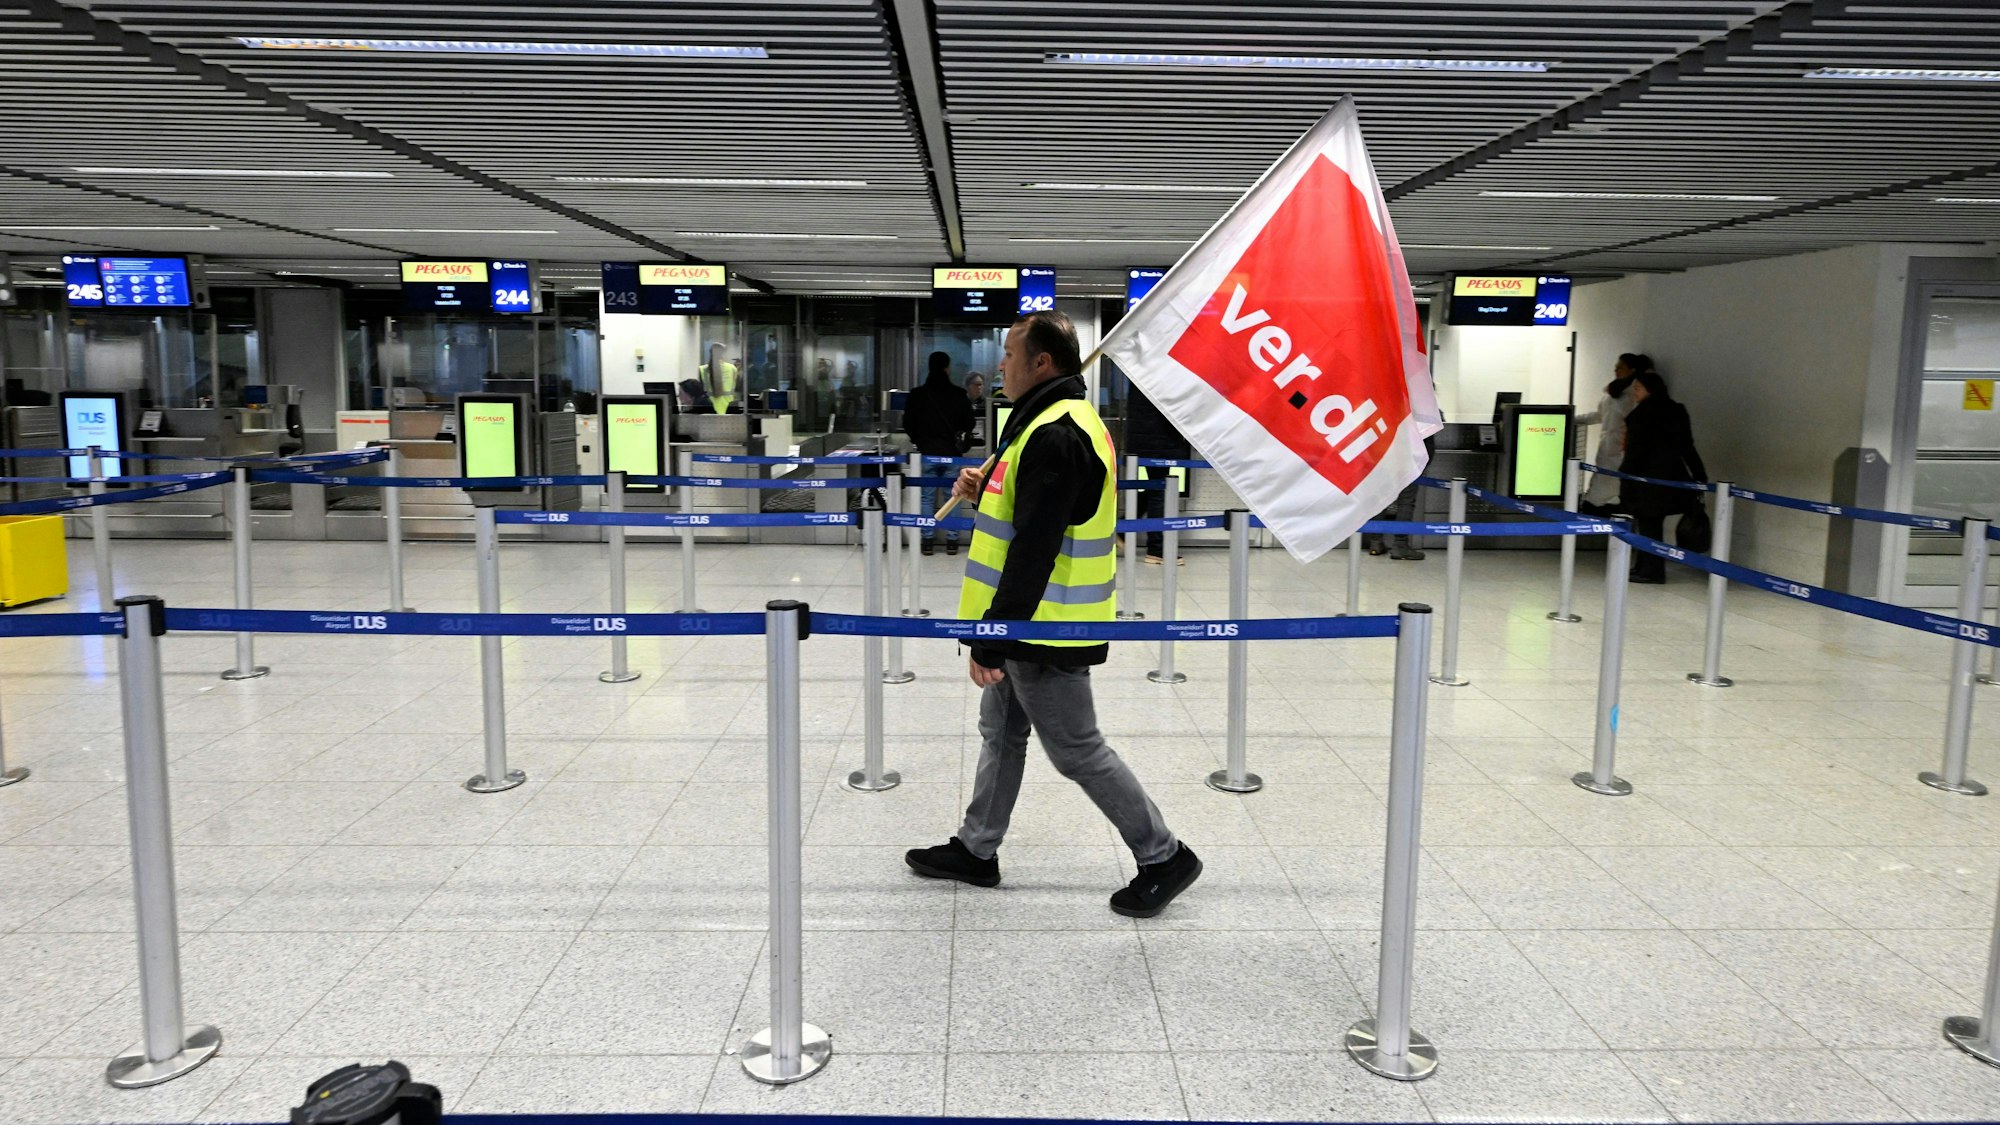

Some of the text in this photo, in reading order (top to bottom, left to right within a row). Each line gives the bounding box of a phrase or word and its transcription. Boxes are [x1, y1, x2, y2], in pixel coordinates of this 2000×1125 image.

[415, 264, 472, 275] PEGASUS
[653, 267, 710, 278] PEGASUS
[946, 271, 1003, 281] PEGASUS
[1466, 279, 1523, 290] PEGASUS
[67, 284, 103, 300] 245
[495, 289, 530, 305] 244
[606, 291, 638, 306] 243
[1020, 296, 1054, 311] 242
[1533, 303, 1567, 319] 240
[1220, 283, 1388, 463] ver.di
[77, 412, 106, 424] DUS
[549, 513, 569, 521] DUS
[690, 515, 710, 524] DUS
[829, 514, 849, 523] DUS
[916, 517, 936, 527] DUS
[1187, 518, 1207, 527] DUS
[1450, 525, 1472, 533] DUS
[1592, 524, 1613, 532] DUS
[1788, 583, 1811, 598] DUS
[354, 615, 388, 630] DUS
[594, 617, 627, 631] DUS
[976, 623, 1008, 636] DUS
[1207, 623, 1239, 637] DUS
[1959, 623, 1990, 641] DUS
